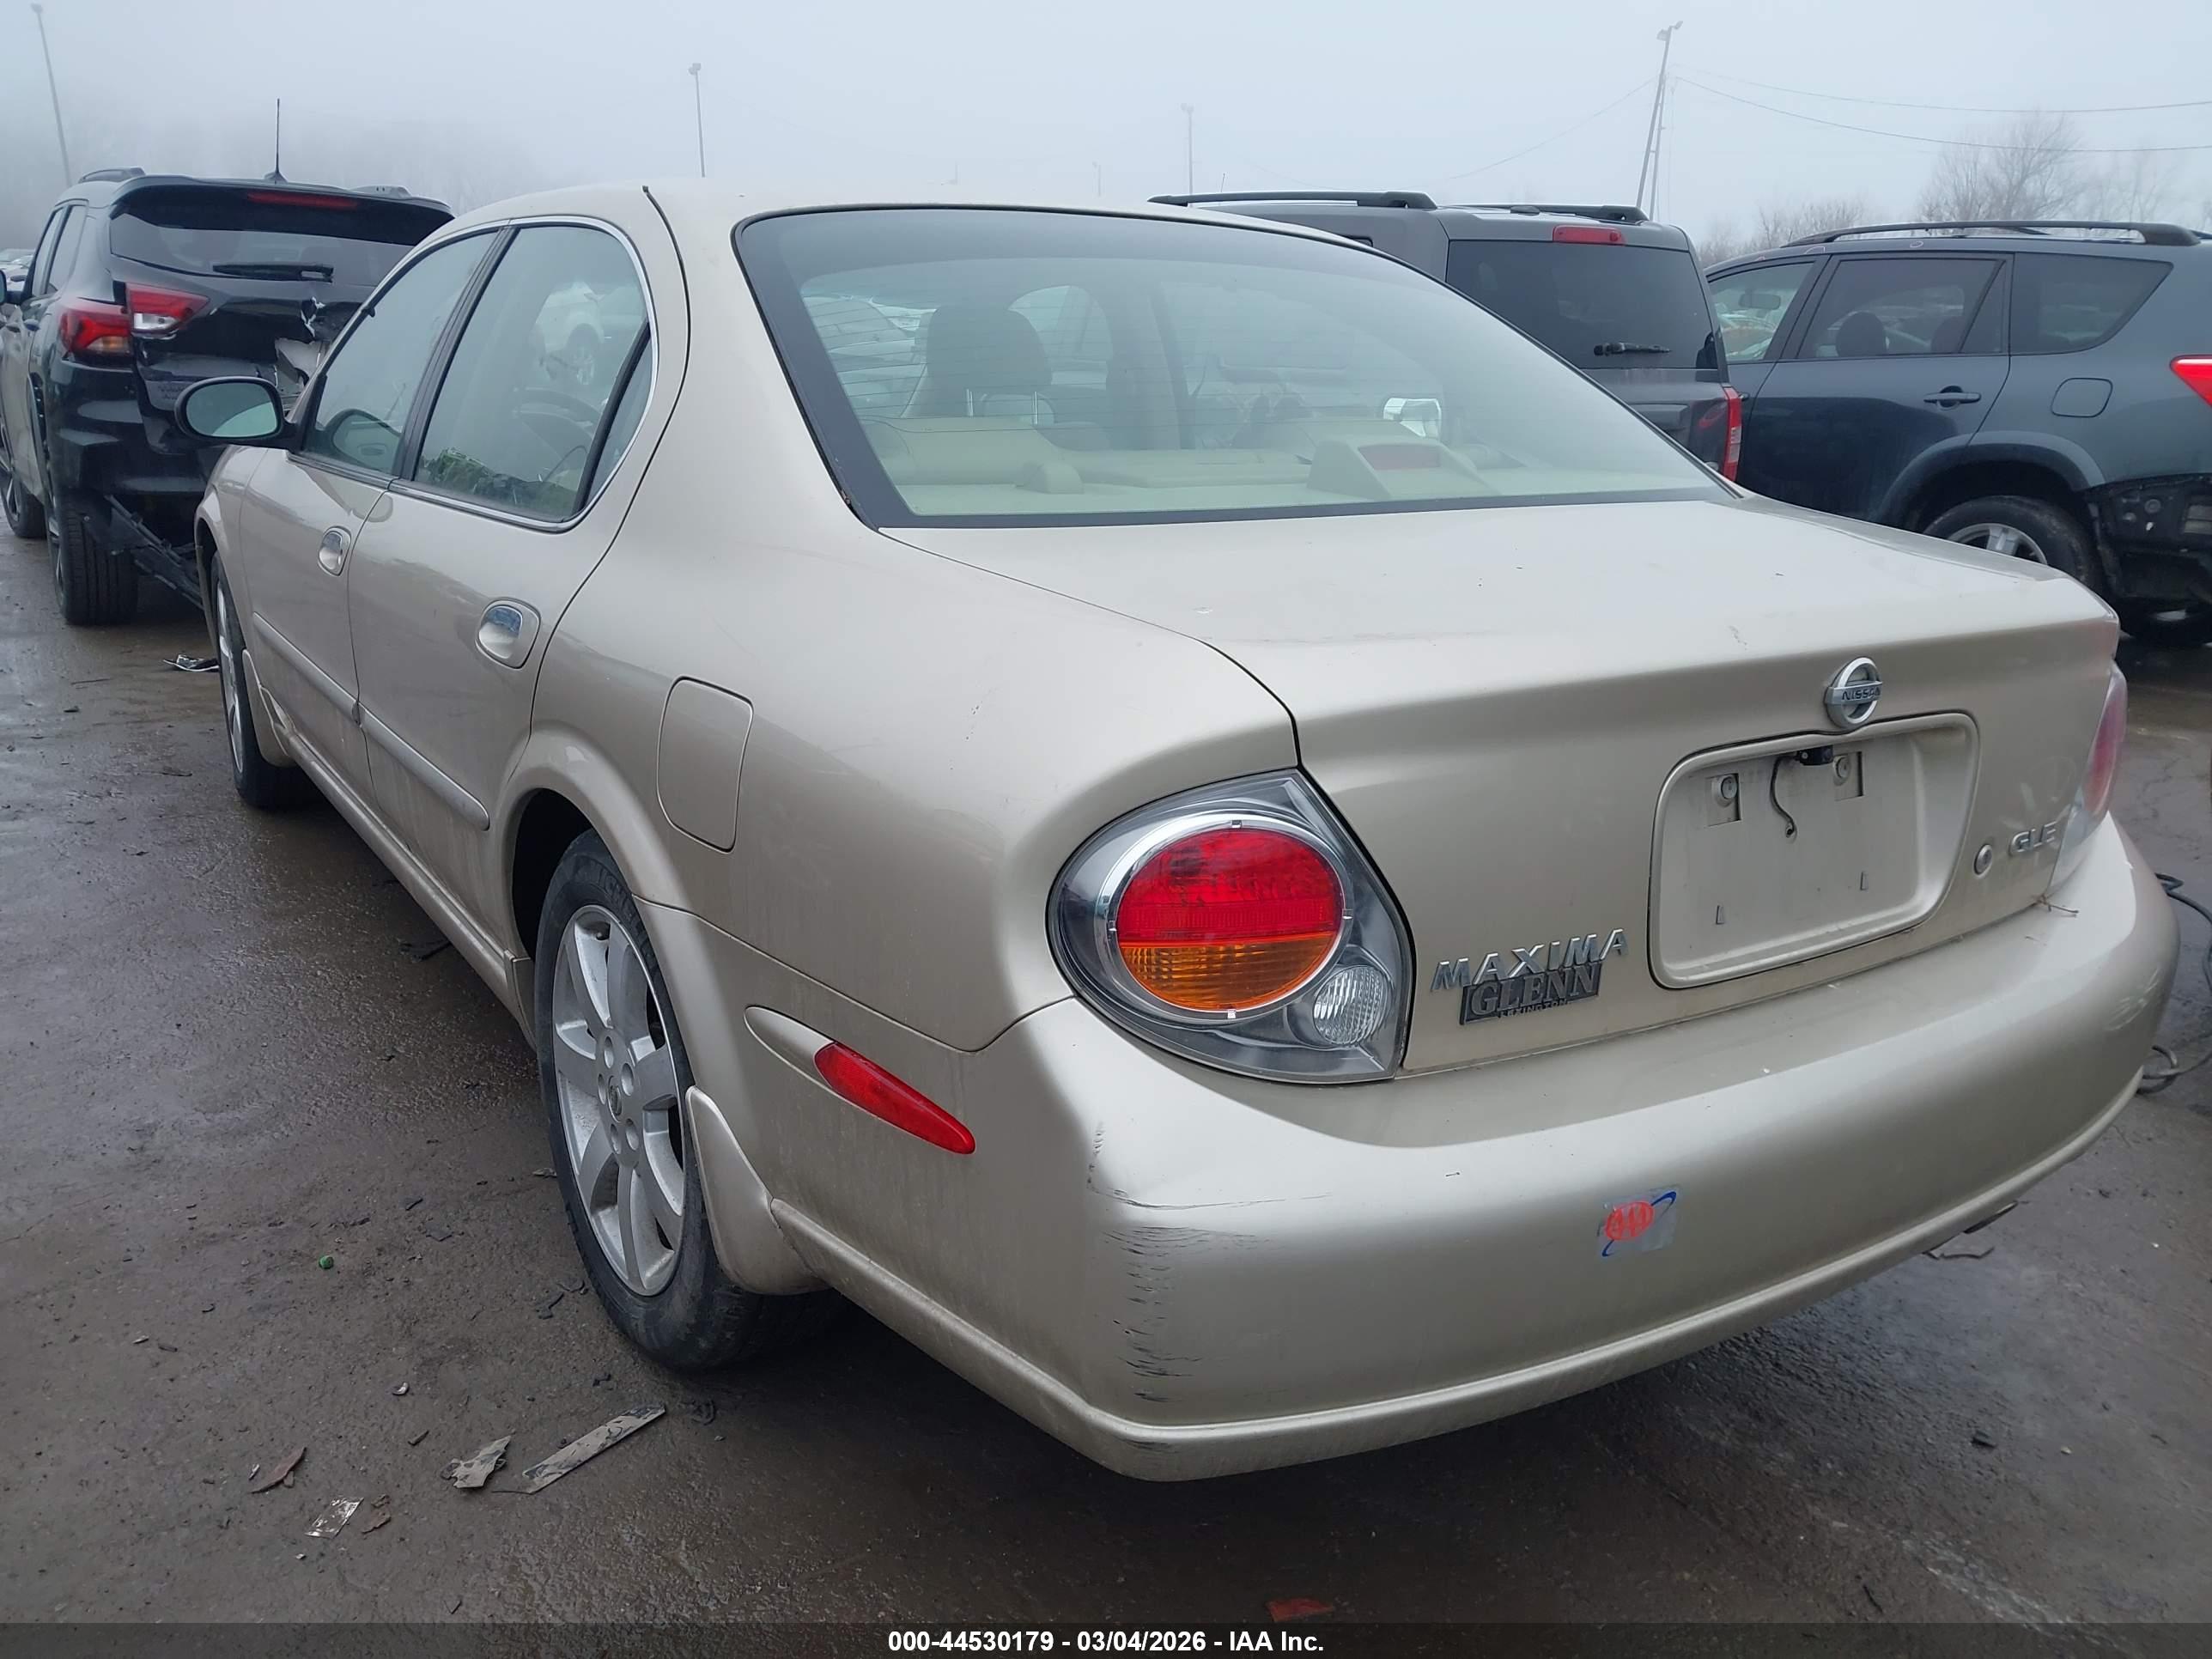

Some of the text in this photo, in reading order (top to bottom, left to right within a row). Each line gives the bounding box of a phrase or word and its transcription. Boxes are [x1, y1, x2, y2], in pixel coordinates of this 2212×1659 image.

[2009, 821, 2057, 853] GLE
[1431, 928, 1628, 992] MAXIMA
[1470, 963, 1598, 1017] GLENN
